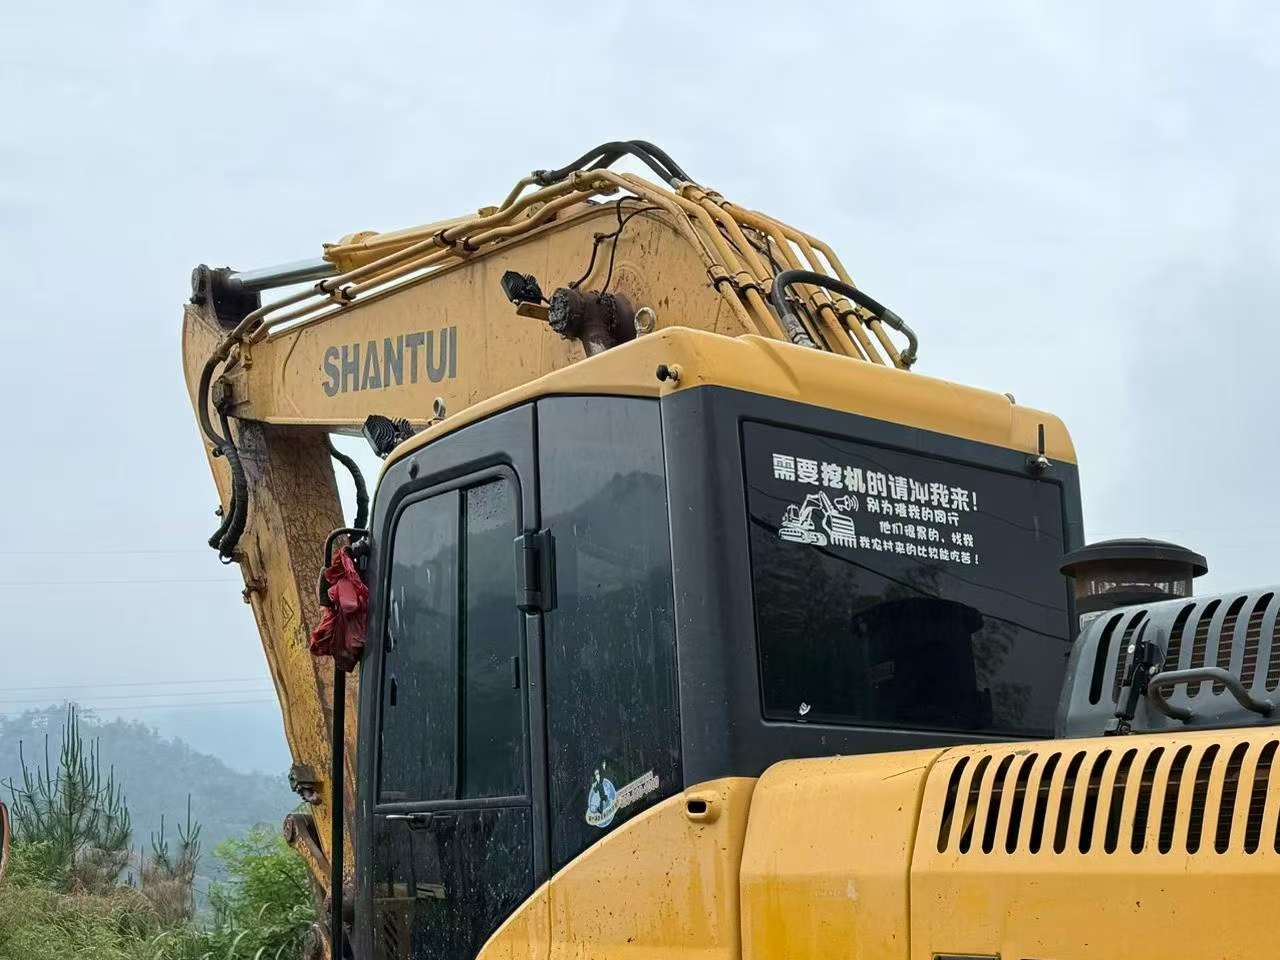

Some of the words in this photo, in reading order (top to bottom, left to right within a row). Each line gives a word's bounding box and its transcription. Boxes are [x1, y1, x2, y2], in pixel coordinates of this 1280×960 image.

[323, 326, 457, 397] SHANTUI
[866, 497, 960, 526] 别为难我的同行
